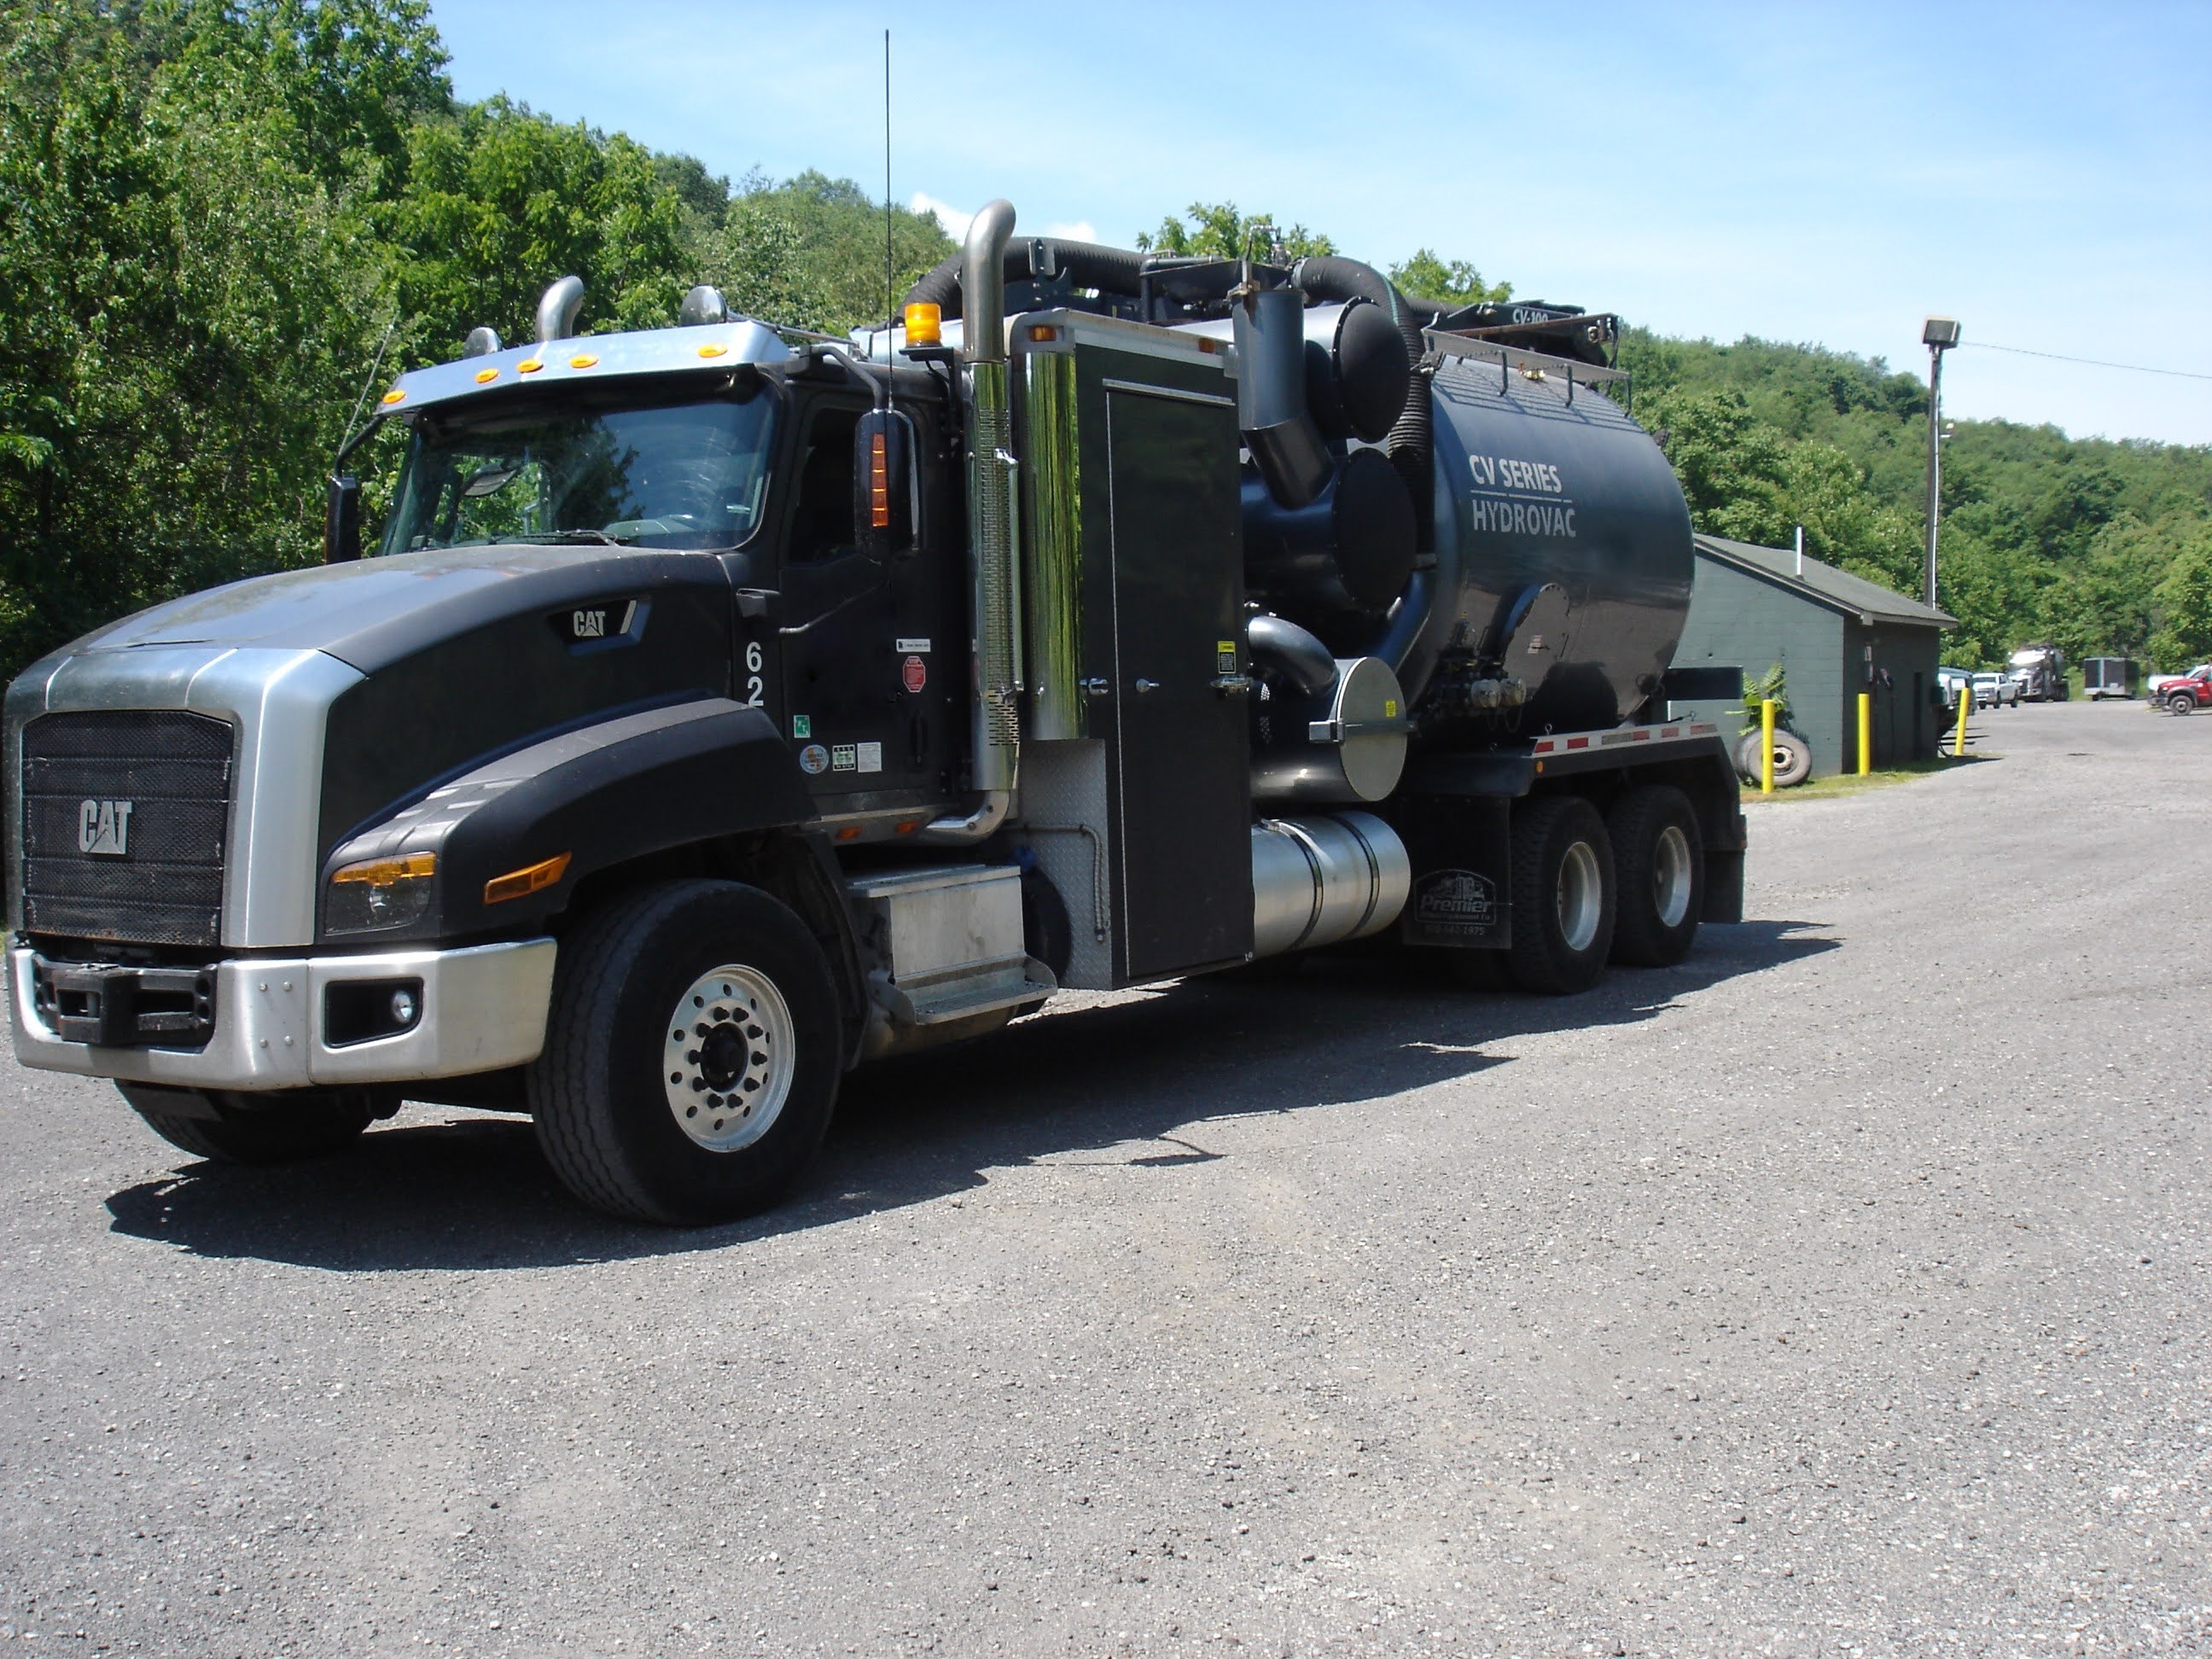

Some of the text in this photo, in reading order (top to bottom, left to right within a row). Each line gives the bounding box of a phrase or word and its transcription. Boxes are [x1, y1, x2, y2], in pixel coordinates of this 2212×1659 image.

[1469, 454, 1563, 494] CV SERIES
[1472, 499, 1577, 538] HYDROVAC
[573, 611, 606, 637] CAT
[79, 800, 132, 855] CAT
